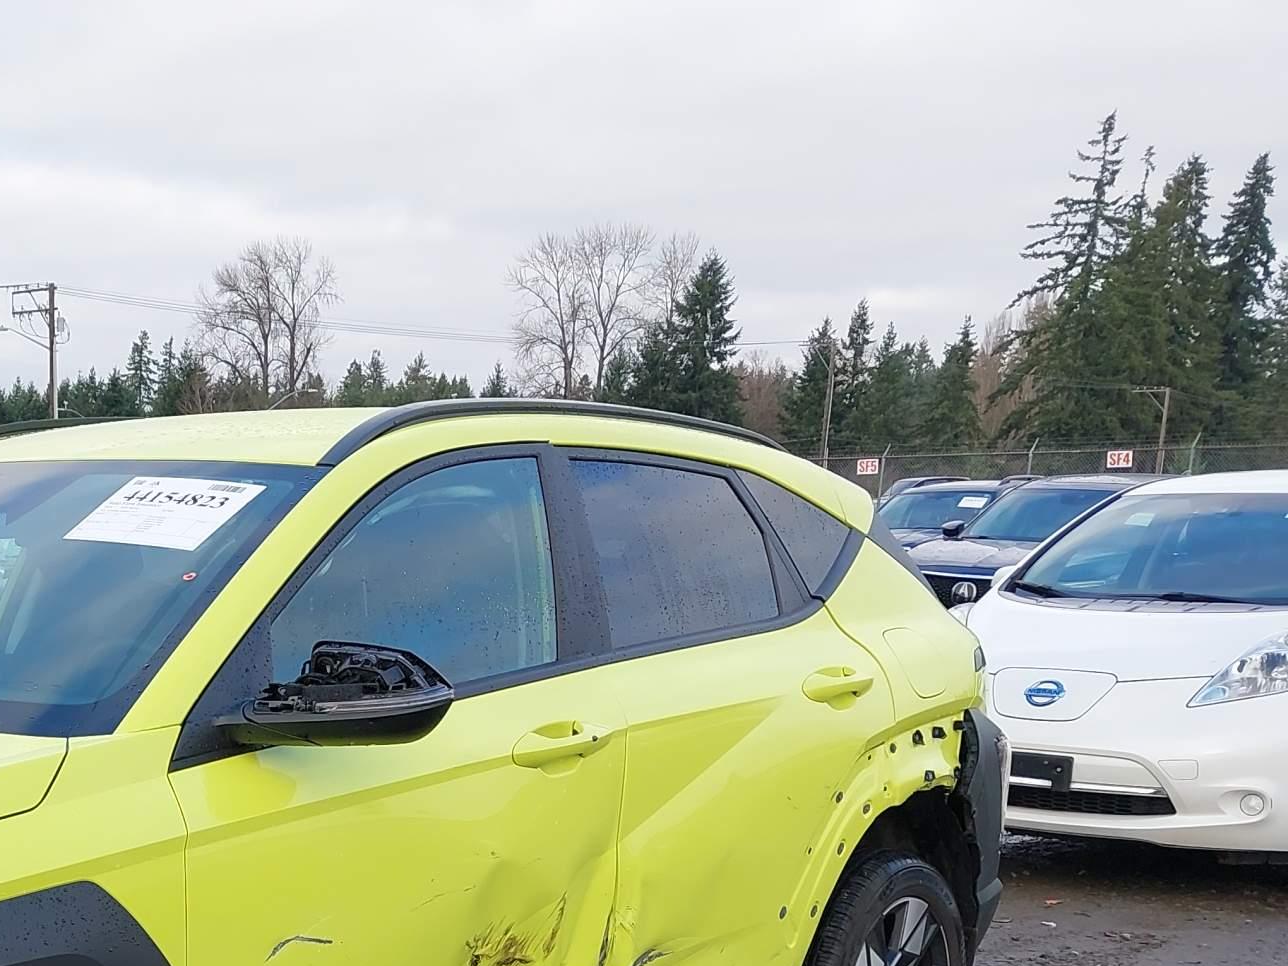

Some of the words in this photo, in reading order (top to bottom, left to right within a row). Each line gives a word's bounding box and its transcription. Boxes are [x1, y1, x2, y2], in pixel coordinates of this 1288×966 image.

[1109, 452, 1130, 466] SF4
[858, 460, 877, 473] SF5
[123, 489, 230, 509] 44154823
